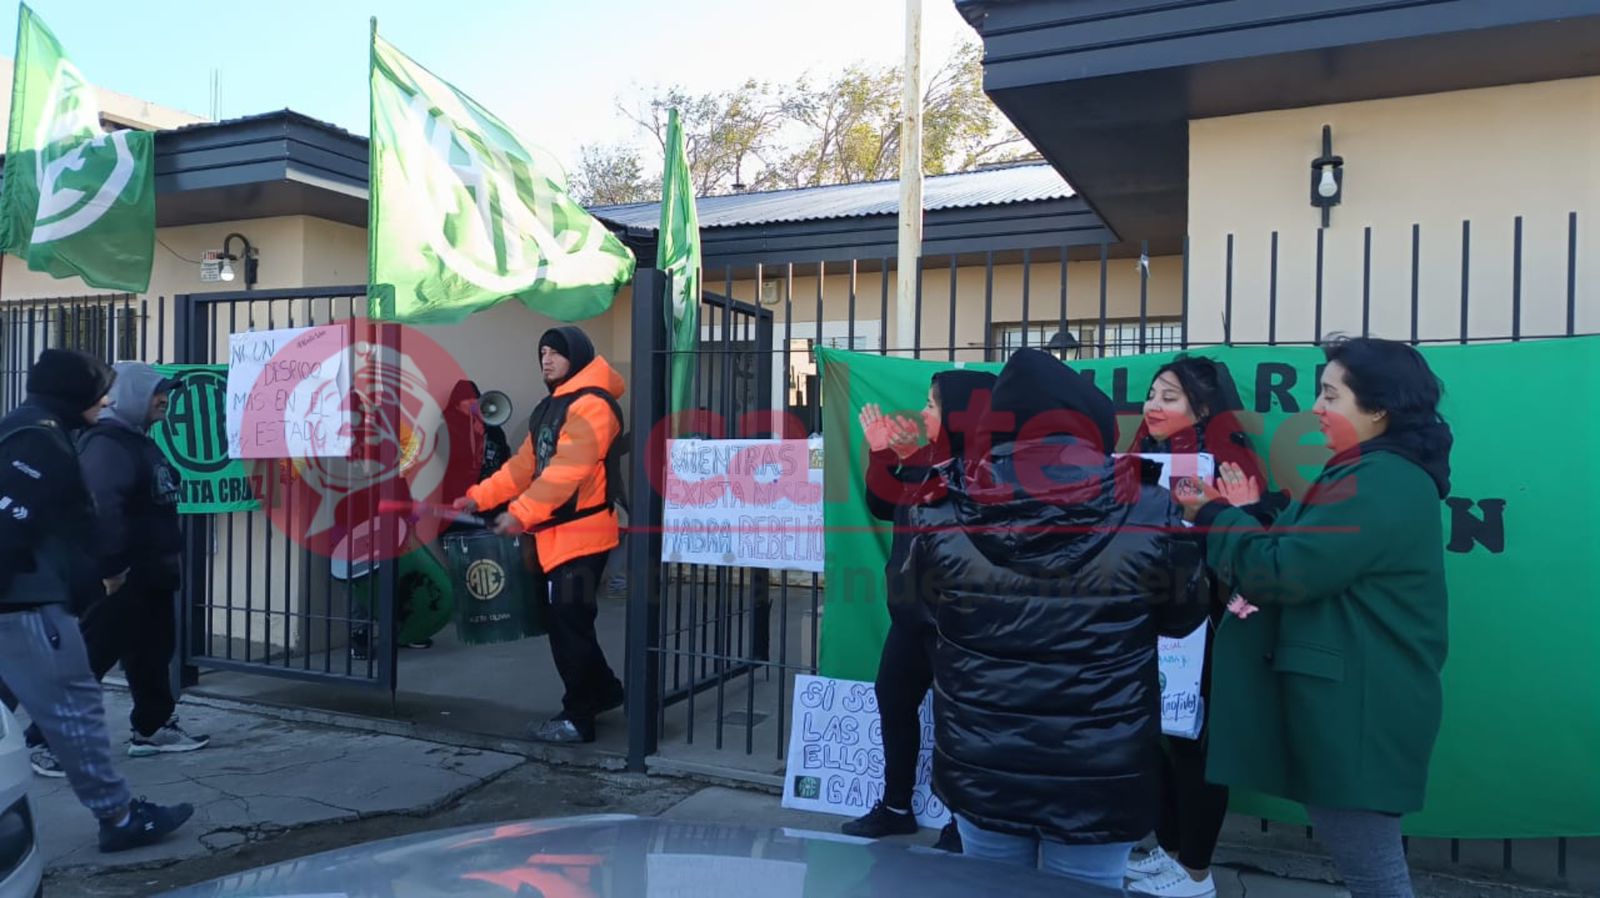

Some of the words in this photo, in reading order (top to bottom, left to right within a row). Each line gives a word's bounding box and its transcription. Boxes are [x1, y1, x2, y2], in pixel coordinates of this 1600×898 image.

[233, 390, 266, 412] MAS
[275, 388, 297, 413] EN
[671, 441, 798, 476] MIENTRAS
[177, 479, 215, 504] NTA
[218, 475, 265, 503] CRUZ
[842, 683, 881, 714] SO
[802, 711, 860, 746] LAS
[803, 743, 886, 780] ELLOS
